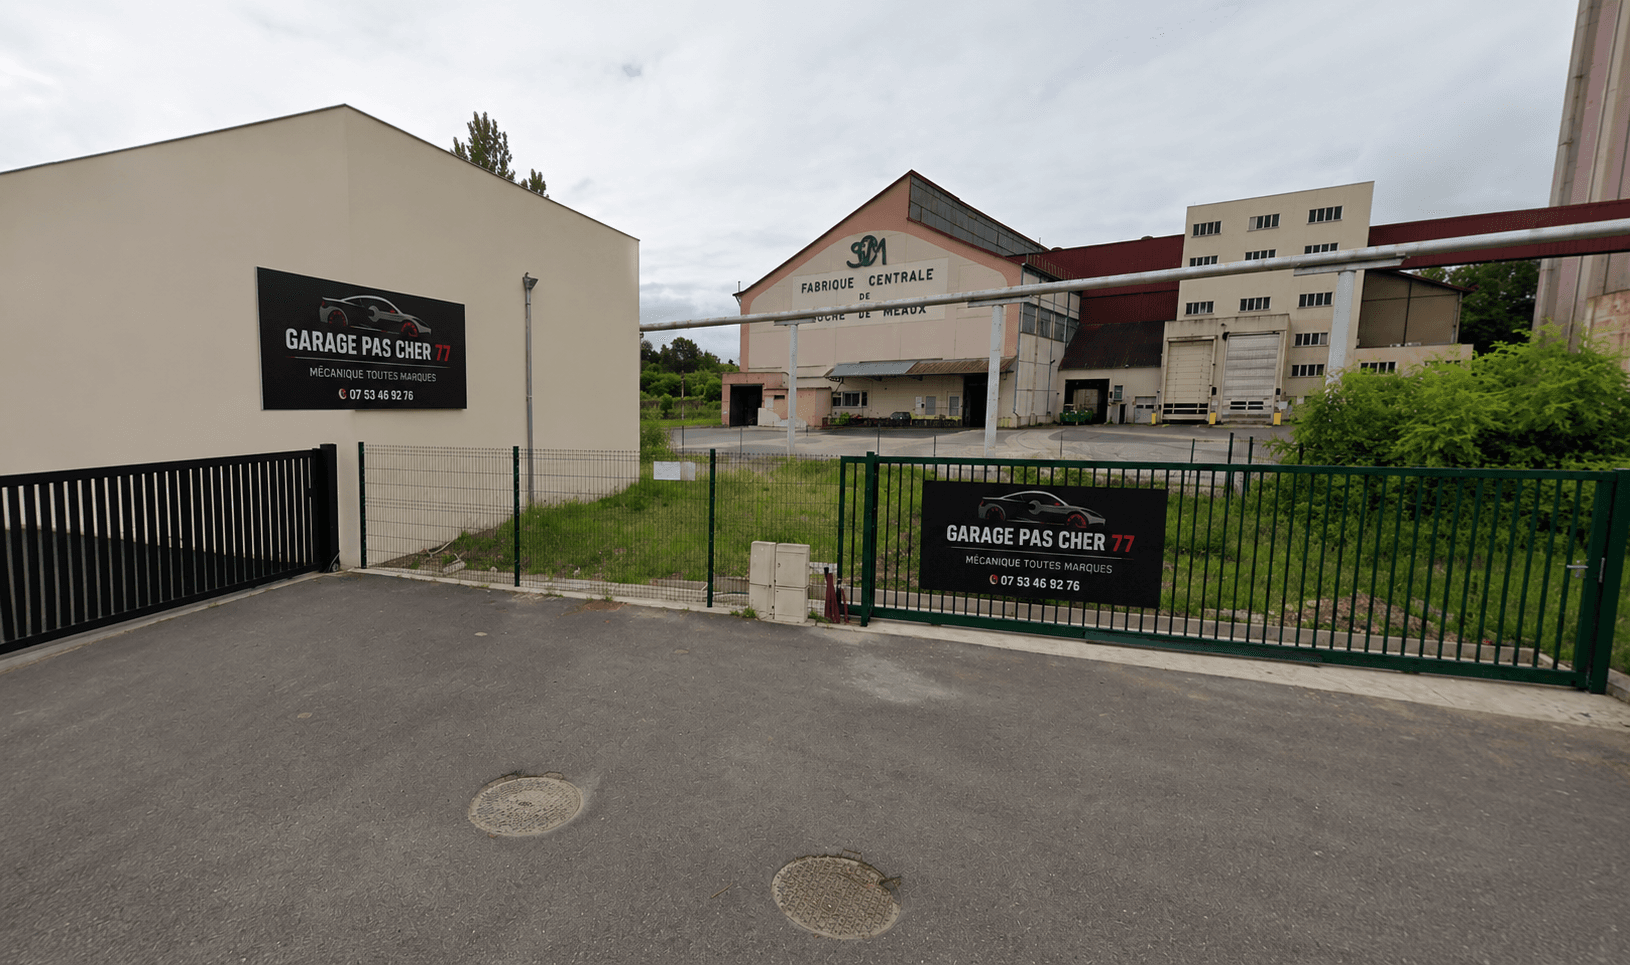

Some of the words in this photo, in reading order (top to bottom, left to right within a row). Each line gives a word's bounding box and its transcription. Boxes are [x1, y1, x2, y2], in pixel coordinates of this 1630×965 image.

[801, 277, 854, 294] FABRIQUE
[868, 268, 934, 286] CENTRALE
[859, 292, 870, 300] DE
[883, 305, 927, 317] MEAUX
[285, 328, 357, 355] GARAGE
[362, 336, 391, 358] PAS
[395, 340, 431, 361] CHER
[435, 344, 451, 362] 77
[366, 370, 398, 380] TOUTES
[400, 372, 437, 382] MARQUES
[349, 389, 361, 400] 07
[364, 389, 376, 400] 53
[377, 390, 389, 400] 46
[946, 524, 1014, 545] GARAGE
[1019, 528, 1053, 548] PAS
[1058, 530, 1105, 551] CHER
[1111, 534, 1135, 552] 77
[965, 553, 1021, 568] MÉCANIQUE
[1023, 559, 1061, 570] TOUTES
[1064, 562, 1113, 575] MARQUES
[1000, 575, 1014, 586] 07
[1016, 576, 1030, 587] 53
[1033, 577, 1047, 588] 46
[1050, 578, 1064, 590] 92
[1066, 580, 1080, 591] 76
